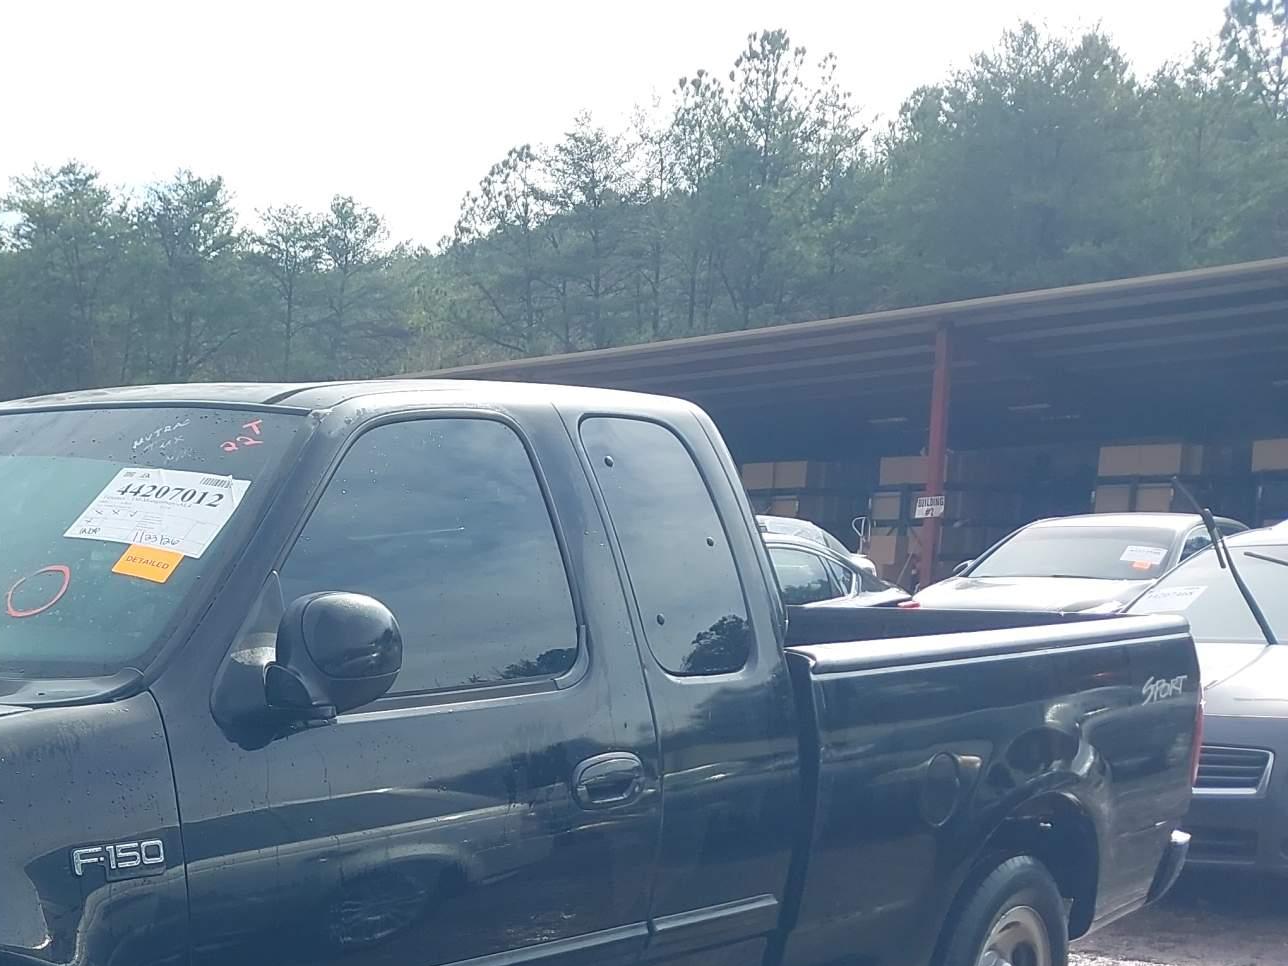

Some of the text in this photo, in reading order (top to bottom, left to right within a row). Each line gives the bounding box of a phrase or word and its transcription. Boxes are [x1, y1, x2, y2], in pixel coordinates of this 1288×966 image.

[116, 482, 224, 508] 44207012
[125, 555, 170, 570] DETAILED
[1141, 674, 1188, 706] SPORT
